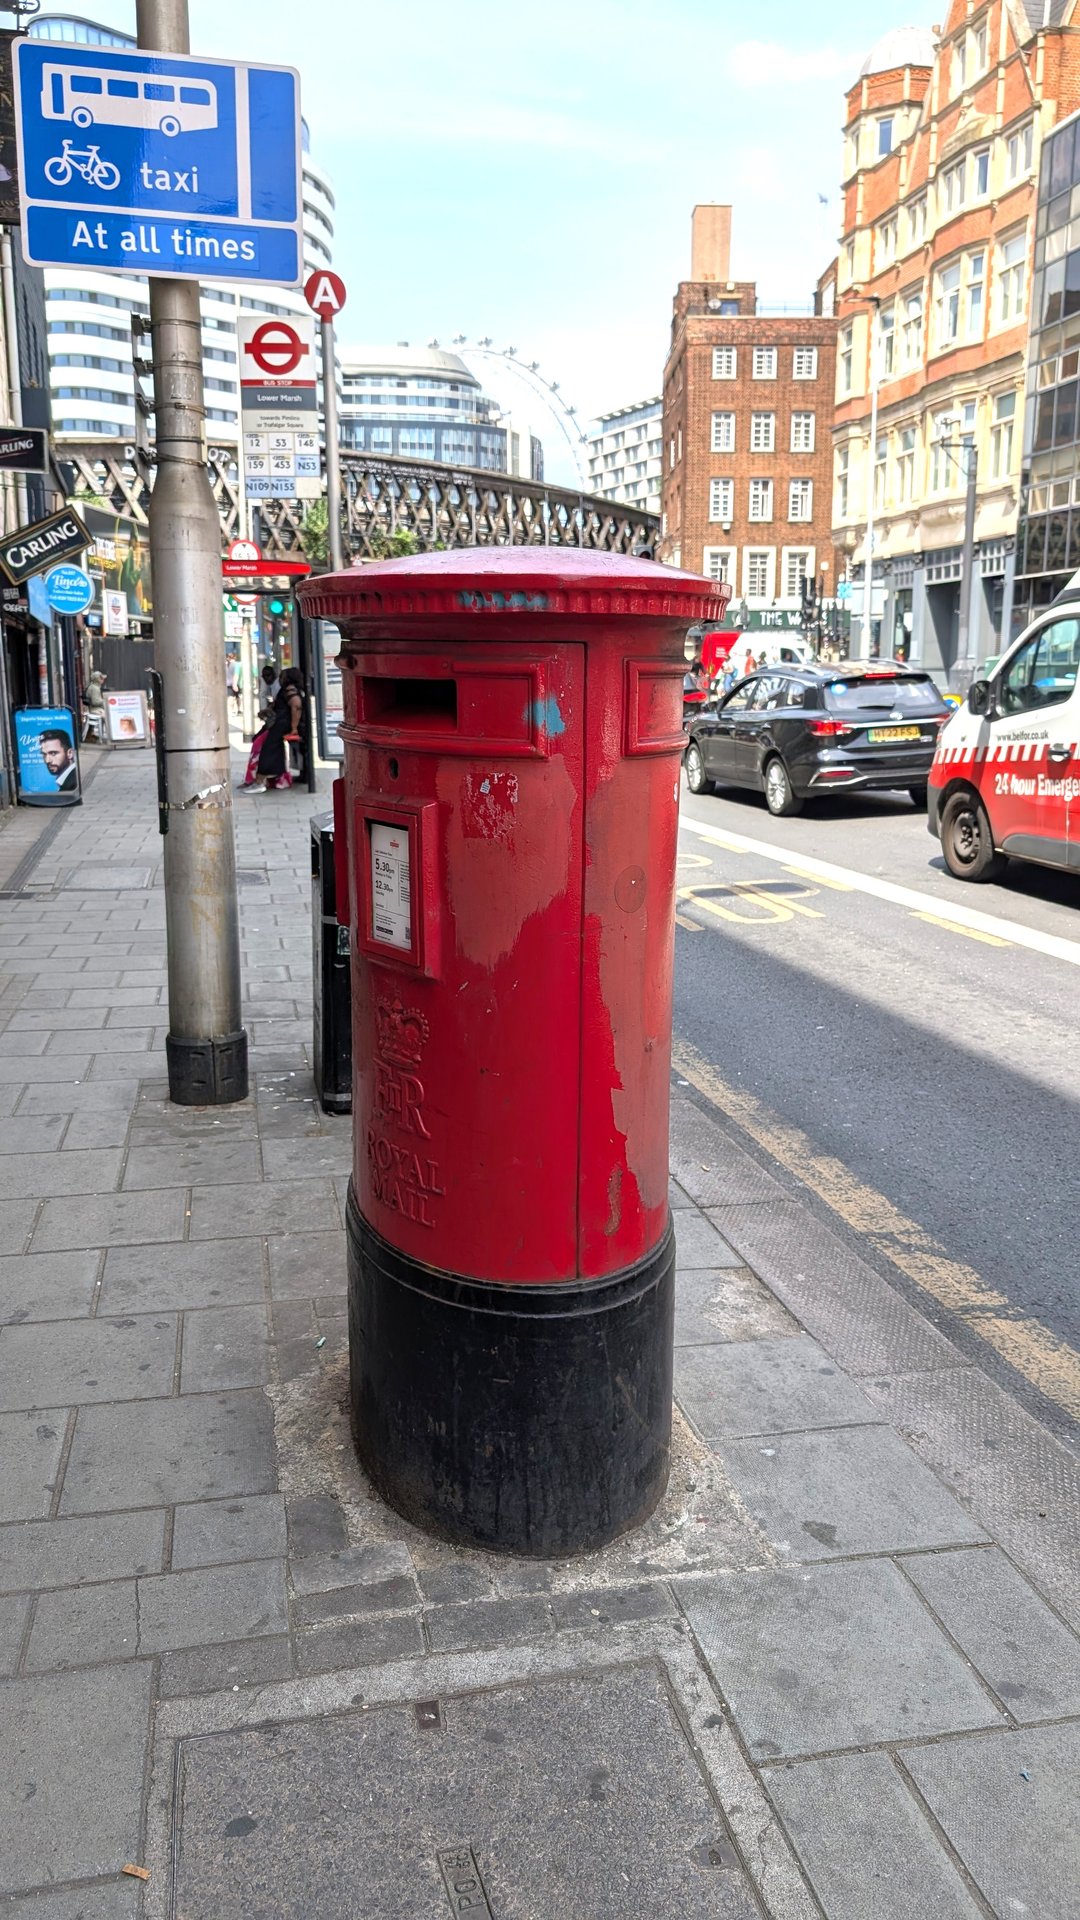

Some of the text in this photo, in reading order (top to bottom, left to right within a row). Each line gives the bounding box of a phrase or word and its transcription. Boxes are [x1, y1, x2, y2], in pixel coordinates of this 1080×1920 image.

[140, 161, 198, 193] taxi
[72, 221, 255, 261] At all times
[312, 277, 340, 309] A
[257, 394, 302, 402] Lower Marsh
[250, 438, 260, 447] 12
[275, 438, 287, 447] 53
[298, 439, 314, 447] 148
[248, 460, 264, 469] 159
[274, 460, 291, 469] 453
[297, 462, 317, 470] N53
[245, 482, 270, 491] N109
[270, 482, 295, 491] N155
[6, 520, 79, 568] CARLING
[760, 611, 783, 626] THE
[996, 730, 1049, 742] www.belfor.co.uk
[995, 772, 1080, 802] 24 hour Emerge
[367, 1127, 446, 1196] ROYAL
[372, 1166, 436, 1228] MAIL
